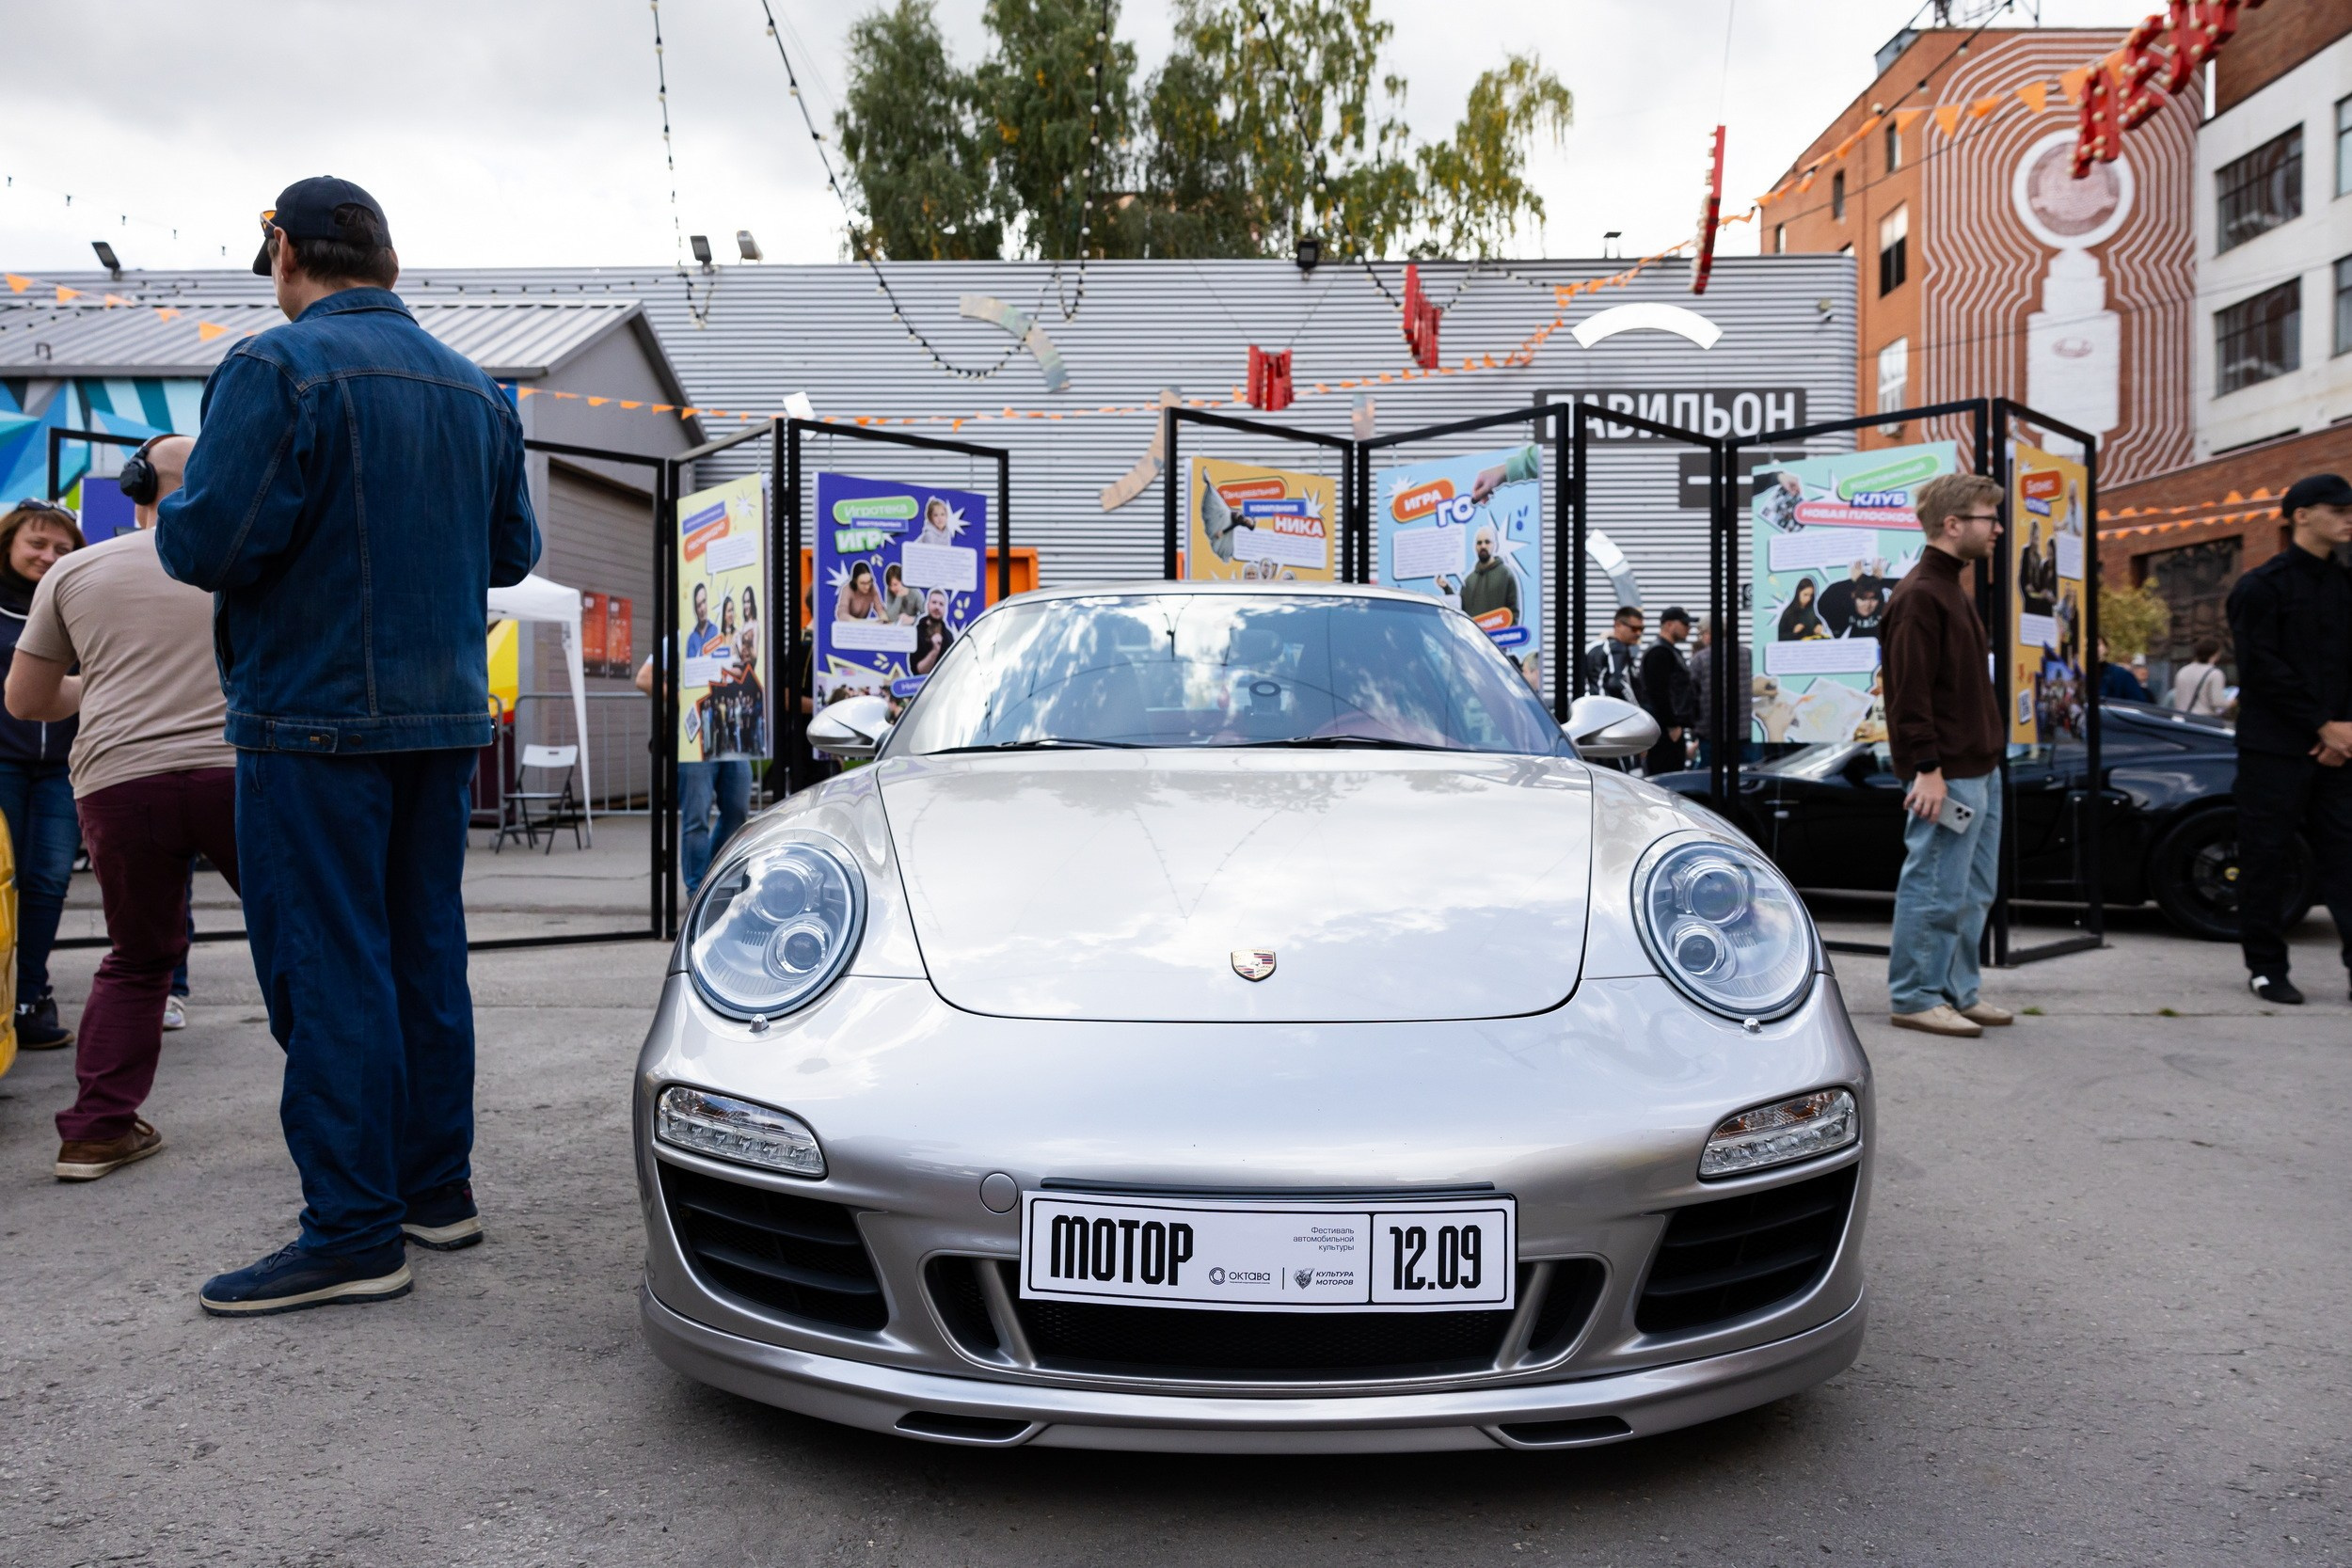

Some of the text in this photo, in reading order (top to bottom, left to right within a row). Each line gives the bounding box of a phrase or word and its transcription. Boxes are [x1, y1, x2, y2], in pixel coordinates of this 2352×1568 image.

[1546, 390, 1795, 439] ПАВИЛЬОН
[843, 503, 908, 518] Игротека
[1404, 488, 1443, 512] ИГРА
[1852, 492, 1906, 507] КЛУБ
[1437, 495, 1477, 527] ГО
[1849, 510, 1916, 523] ПЛОСКОС
[1274, 516, 1325, 537] НИКА
[836, 530, 882, 550] ИГР
[1050, 1214, 1194, 1286] МОТОР
[1389, 1224, 1483, 1291] 12.09
